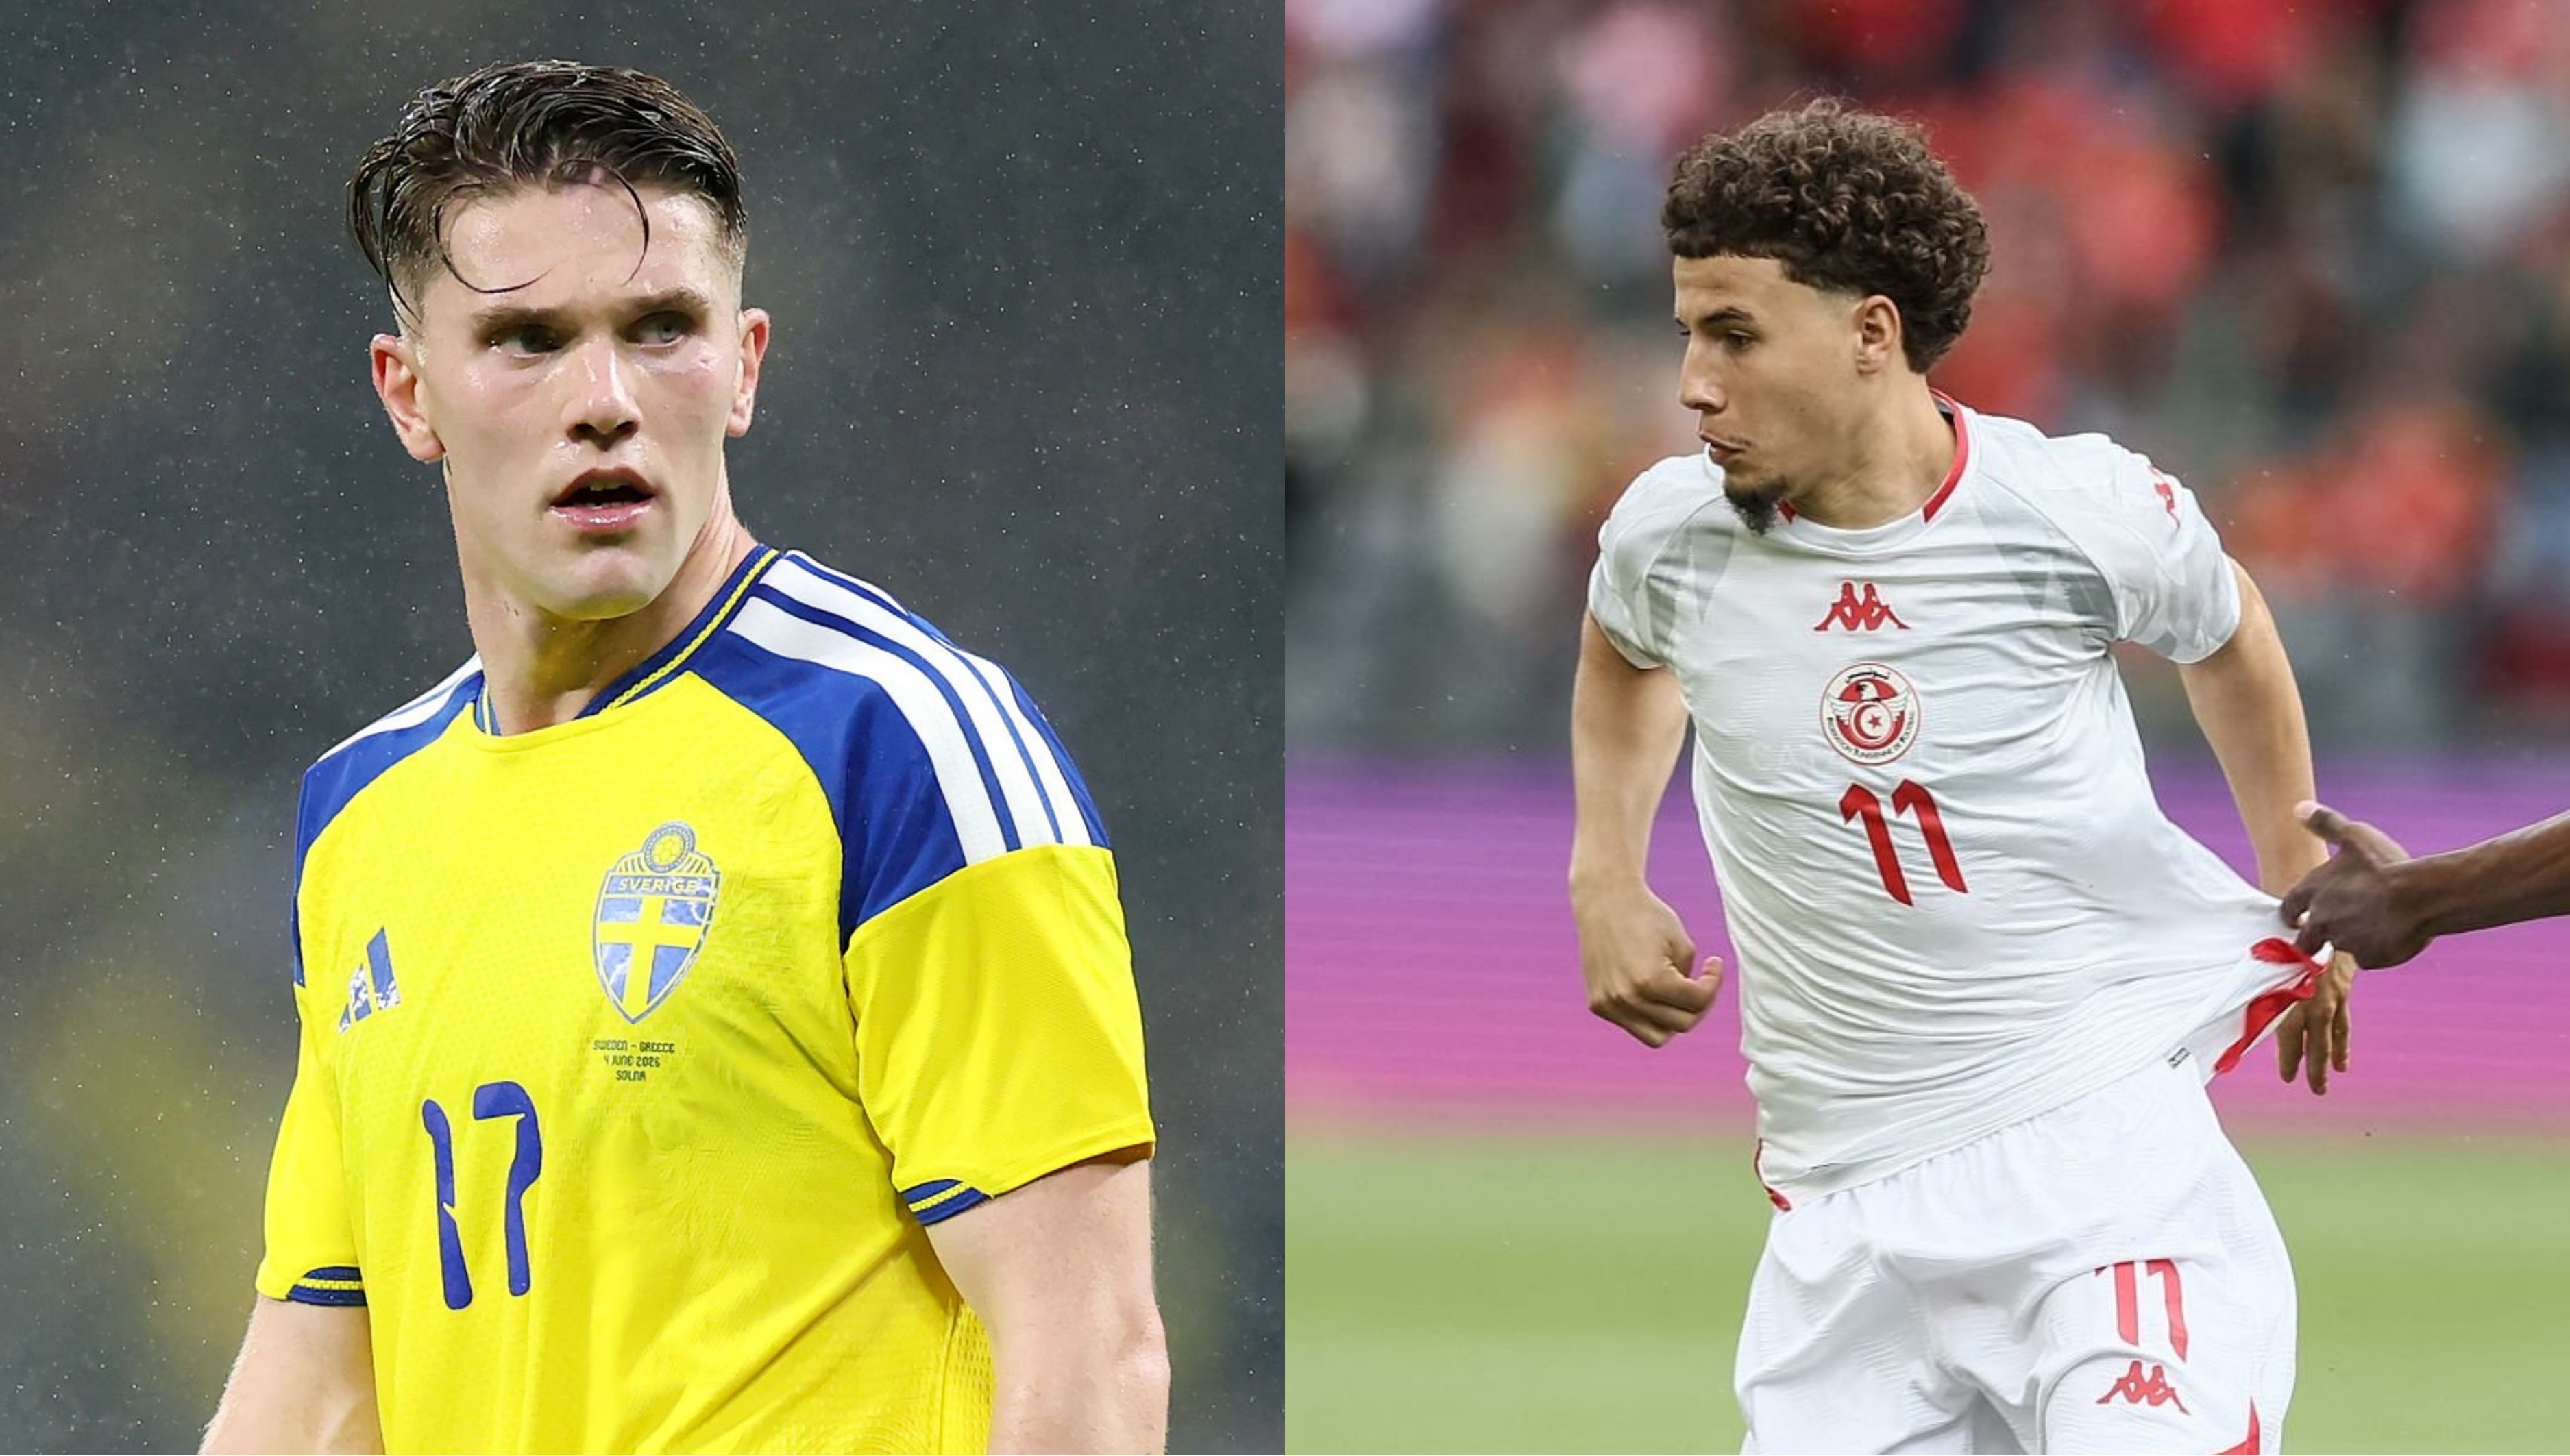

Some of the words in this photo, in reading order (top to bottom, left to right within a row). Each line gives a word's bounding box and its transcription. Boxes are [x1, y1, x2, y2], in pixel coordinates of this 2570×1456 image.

[1839, 778, 1968, 906] 11
[618, 878, 698, 895] SVERIGE
[593, 1040, 627, 1051] SWEDEN
[640, 1041, 674, 1053] GREECE
[611, 1055, 634, 1066] JUNE
[616, 1070, 646, 1081] SOLNA
[421, 1081, 543, 1311] 17
[2094, 1258, 2188, 1364] 11
